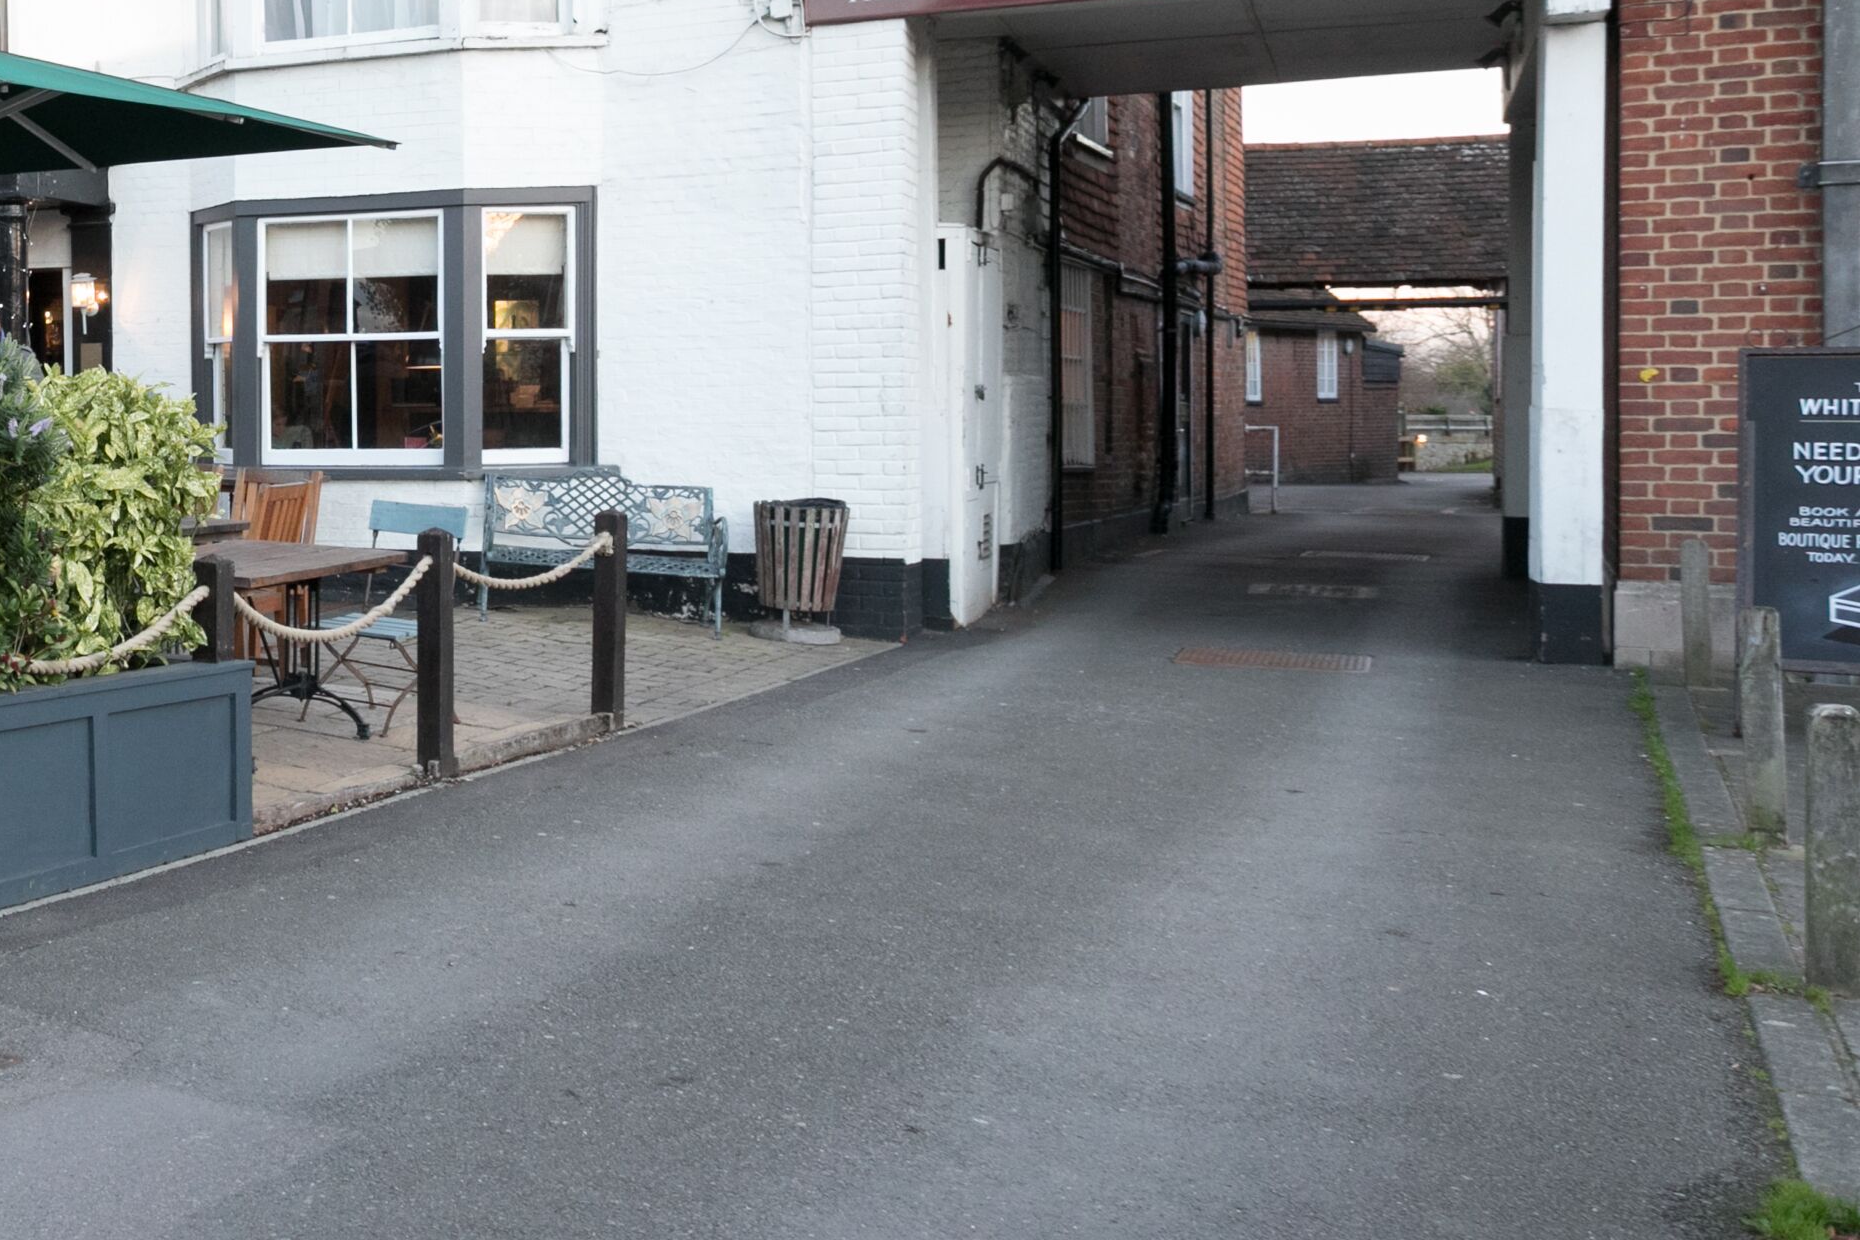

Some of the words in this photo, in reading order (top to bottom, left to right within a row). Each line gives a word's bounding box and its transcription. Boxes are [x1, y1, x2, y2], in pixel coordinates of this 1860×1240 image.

[1799, 397, 1860, 416] WHIT
[1792, 441, 1860, 461] NEED
[1799, 505, 1850, 517] BOOK
[1777, 531, 1853, 549] BOUTIQUE
